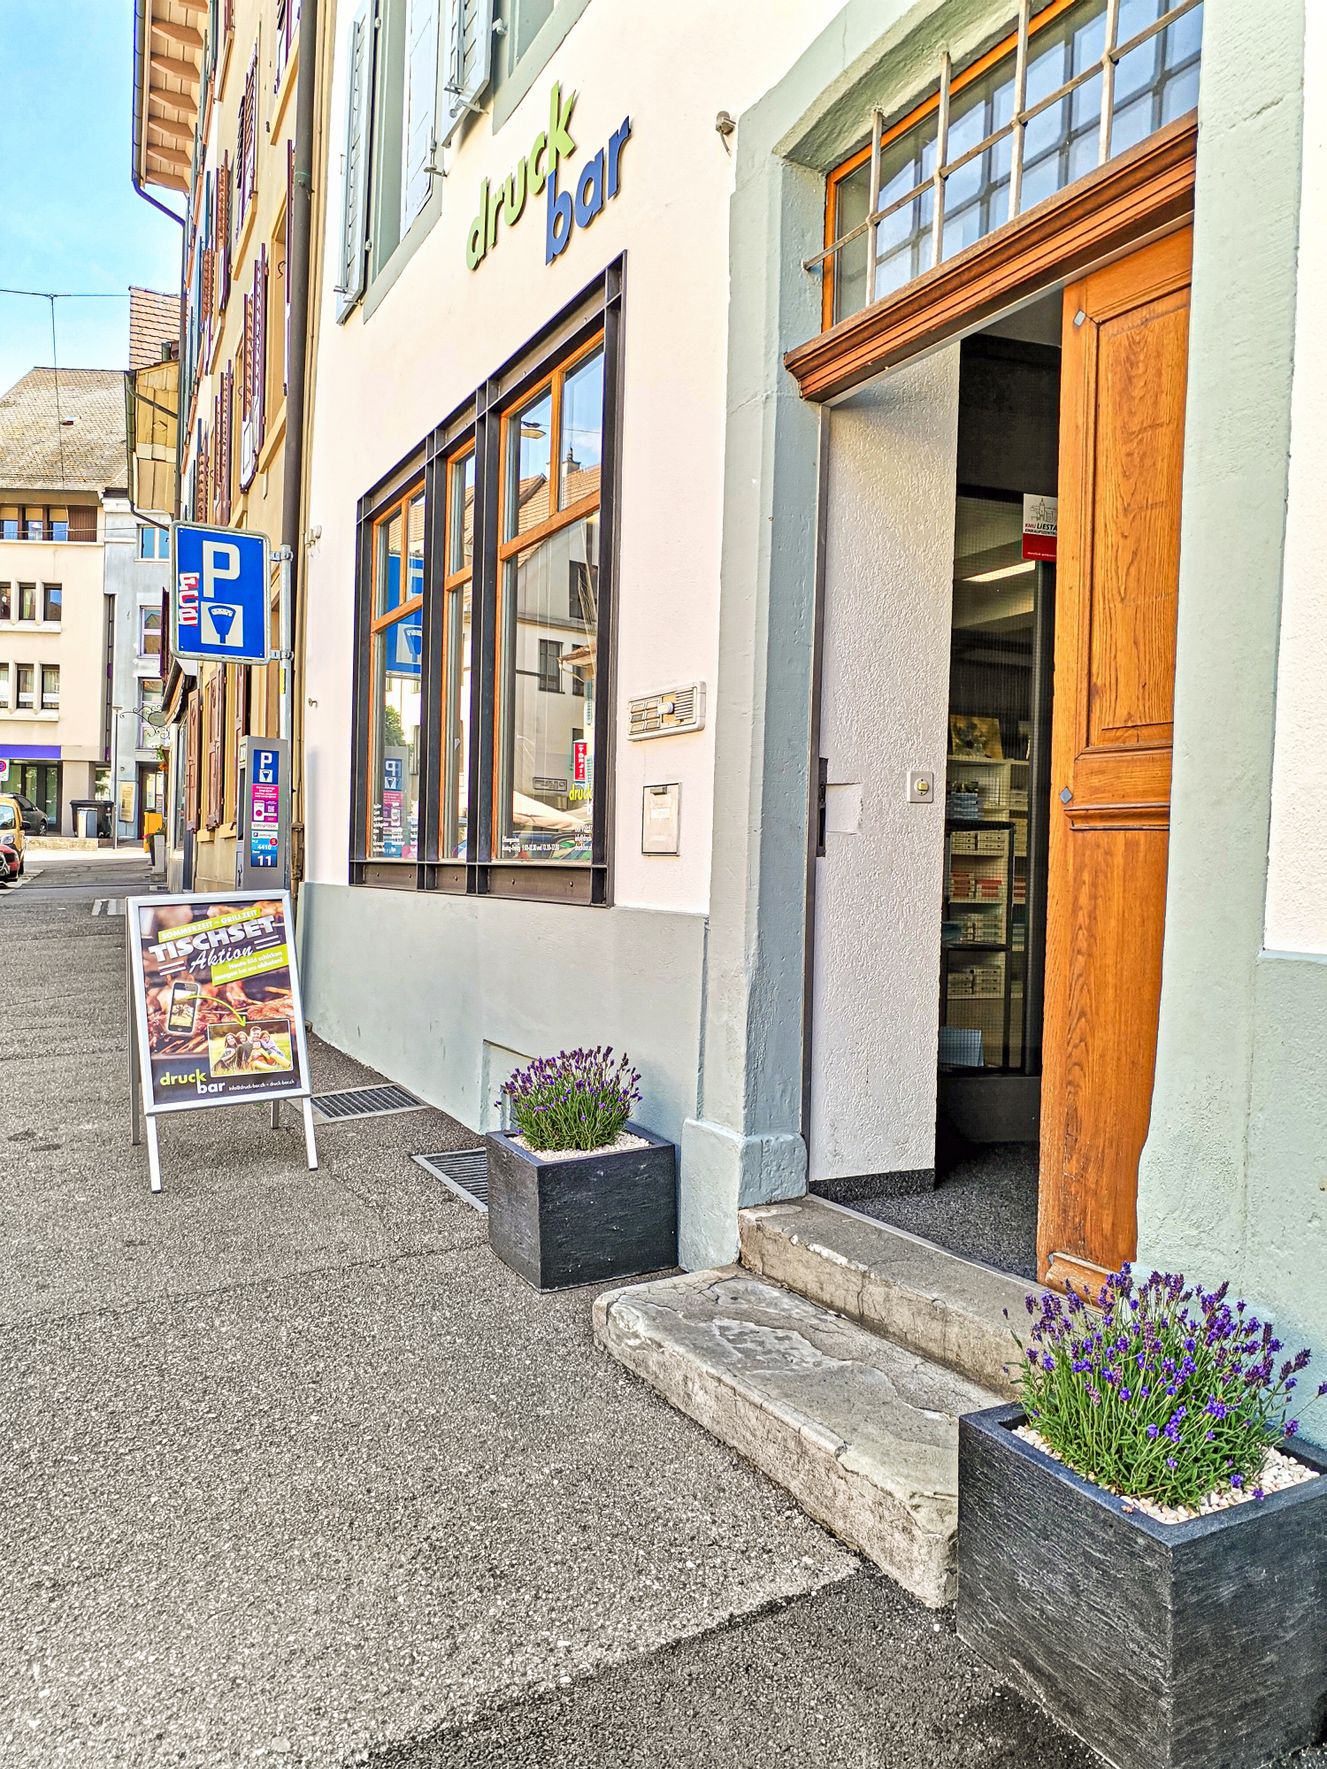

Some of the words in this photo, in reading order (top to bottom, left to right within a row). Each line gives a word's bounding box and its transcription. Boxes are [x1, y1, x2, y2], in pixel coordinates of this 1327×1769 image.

[466, 80, 577, 271] druck
[545, 115, 632, 266] bar
[202, 540, 241, 598] P
[261, 752, 272, 769] P
[257, 855, 272, 866] 11
[162, 921, 213, 938] SOMMERZEIT
[221, 909, 258, 925] GRILLZEIT
[149, 915, 275, 962] TISCHSET
[189, 945, 254, 973] Aktion
[160, 1069, 207, 1086] druck
[197, 1080, 226, 1094] bar
